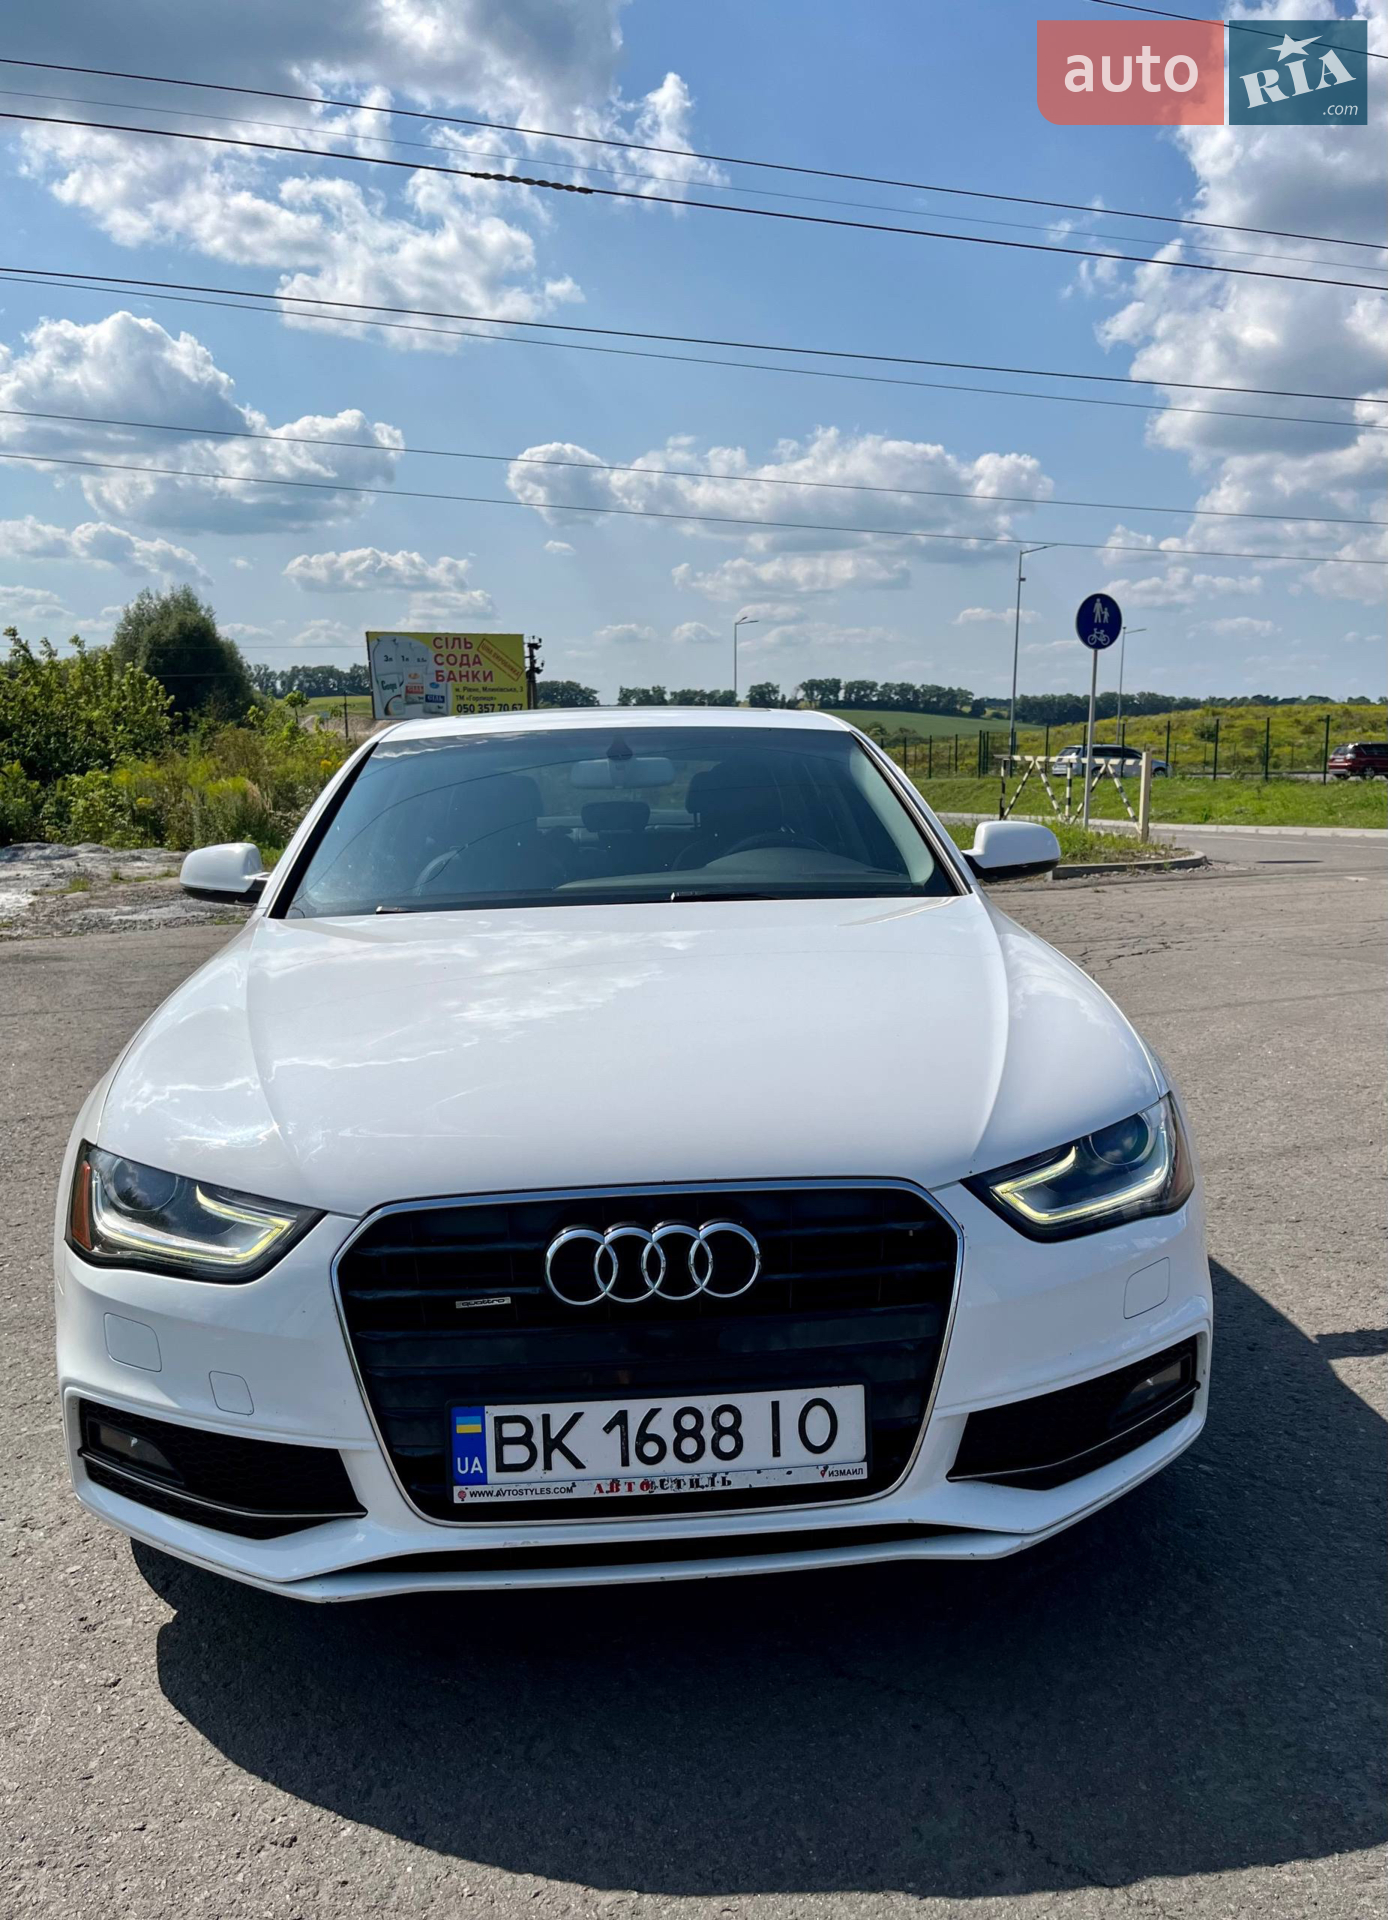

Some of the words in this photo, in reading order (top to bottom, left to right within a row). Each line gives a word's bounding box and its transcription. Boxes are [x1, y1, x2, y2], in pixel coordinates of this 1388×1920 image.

[432, 636, 474, 650] СІЛЬ
[433, 653, 483, 668] СОДА
[435, 669, 494, 683] БАНКИ
[456, 703, 476, 714] 050
[477, 703, 496, 713] 357
[497, 703, 510, 712] 70
[511, 703, 524, 711] 67
[461, 1298, 505, 1307] quattro
[494, 1411, 587, 1473] BK
[602, 1403, 743, 1467] 1688
[770, 1397, 839, 1458] IO
[456, 1455, 484, 1475] UA
[828, 1467, 864, 1478] ИЗМАИЛ
[469, 1486, 574, 1498] WWW.AVTOSTYLES.COM
